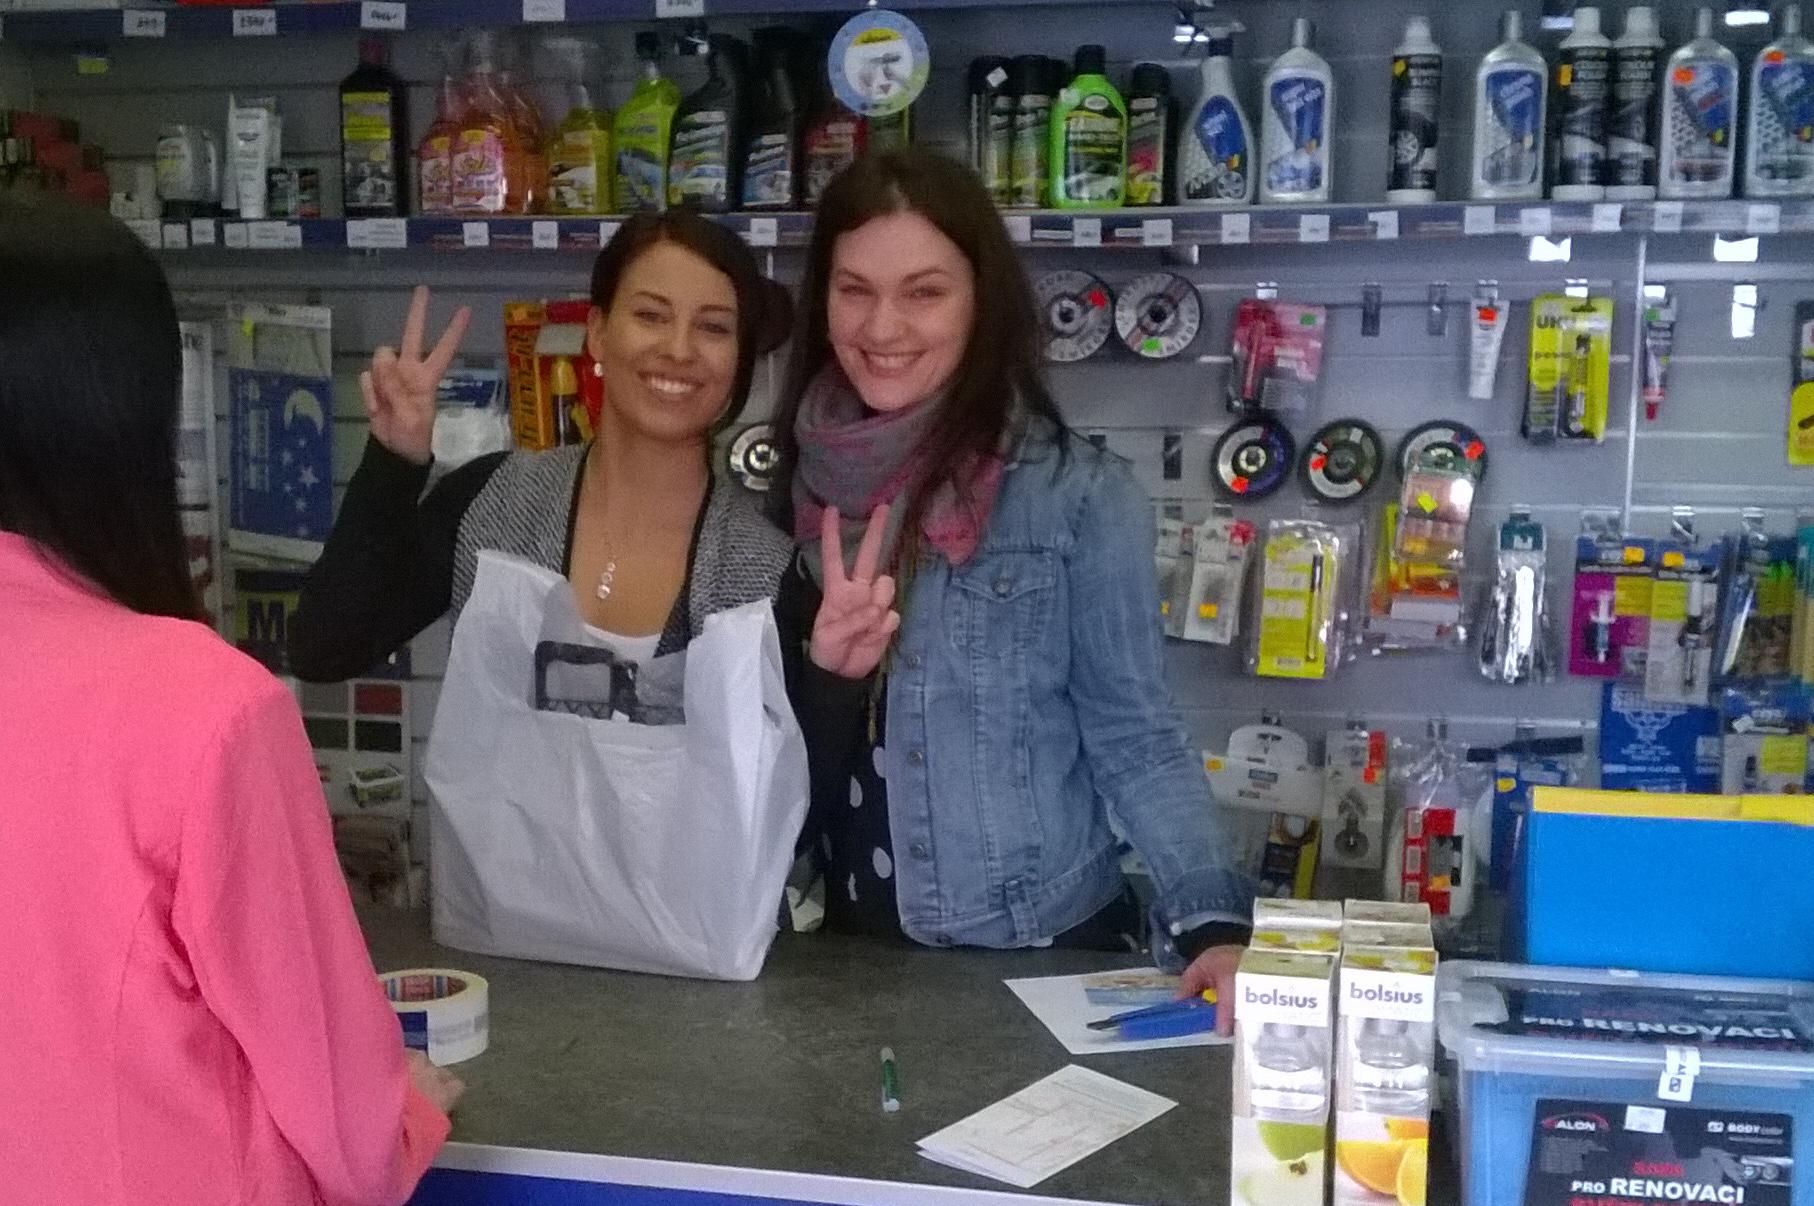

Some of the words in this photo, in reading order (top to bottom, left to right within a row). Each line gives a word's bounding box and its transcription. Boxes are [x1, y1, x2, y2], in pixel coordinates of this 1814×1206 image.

[1245, 986, 1318, 1009] bolsius
[1350, 982, 1424, 1005] bolsius
[1582, 1018, 1796, 1040] RENOVACI
[1570, 1180, 1606, 1195] PRO
[1610, 1177, 1744, 1204] RENOVACI
